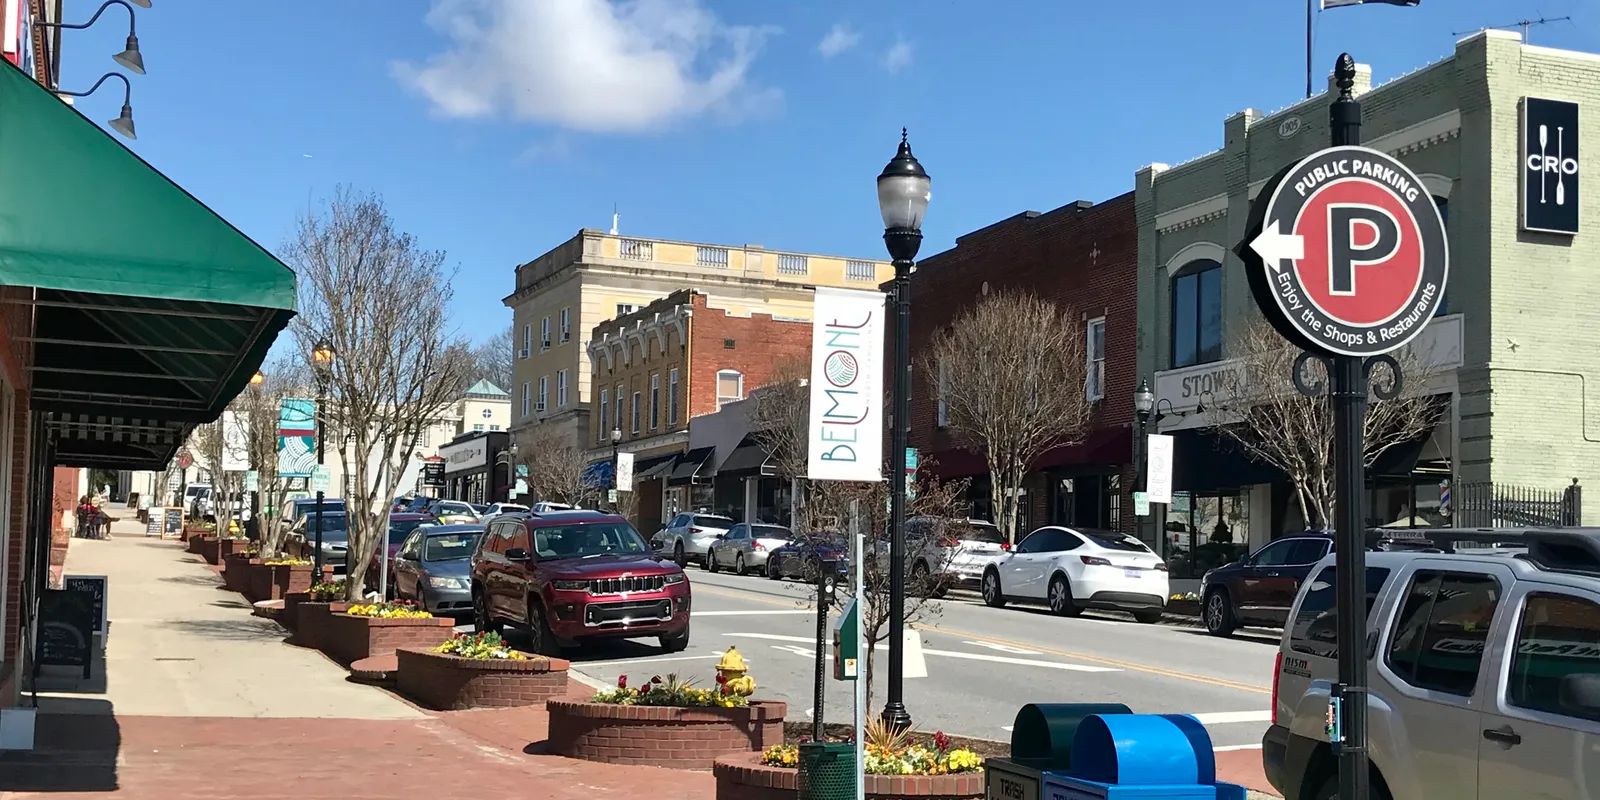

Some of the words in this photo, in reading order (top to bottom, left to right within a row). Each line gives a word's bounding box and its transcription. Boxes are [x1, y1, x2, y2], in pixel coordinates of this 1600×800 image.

[1282, 119, 1298, 135] 1905
[1527, 154, 1578, 175] CRO
[1294, 159, 1349, 197] PUBLIC
[1352, 159, 1419, 203] PARKING
[1327, 203, 1402, 296] P
[1277, 271, 1304, 310] Enjoy
[1301, 308, 1322, 332] the
[1323, 323, 1363, 347] Shops
[1366, 330, 1378, 345] &
[1380, 282, 1437, 342] Restaurants
[1383, 531, 1423, 539] XTERRA
[1000, 778, 1024, 800] TRASH
